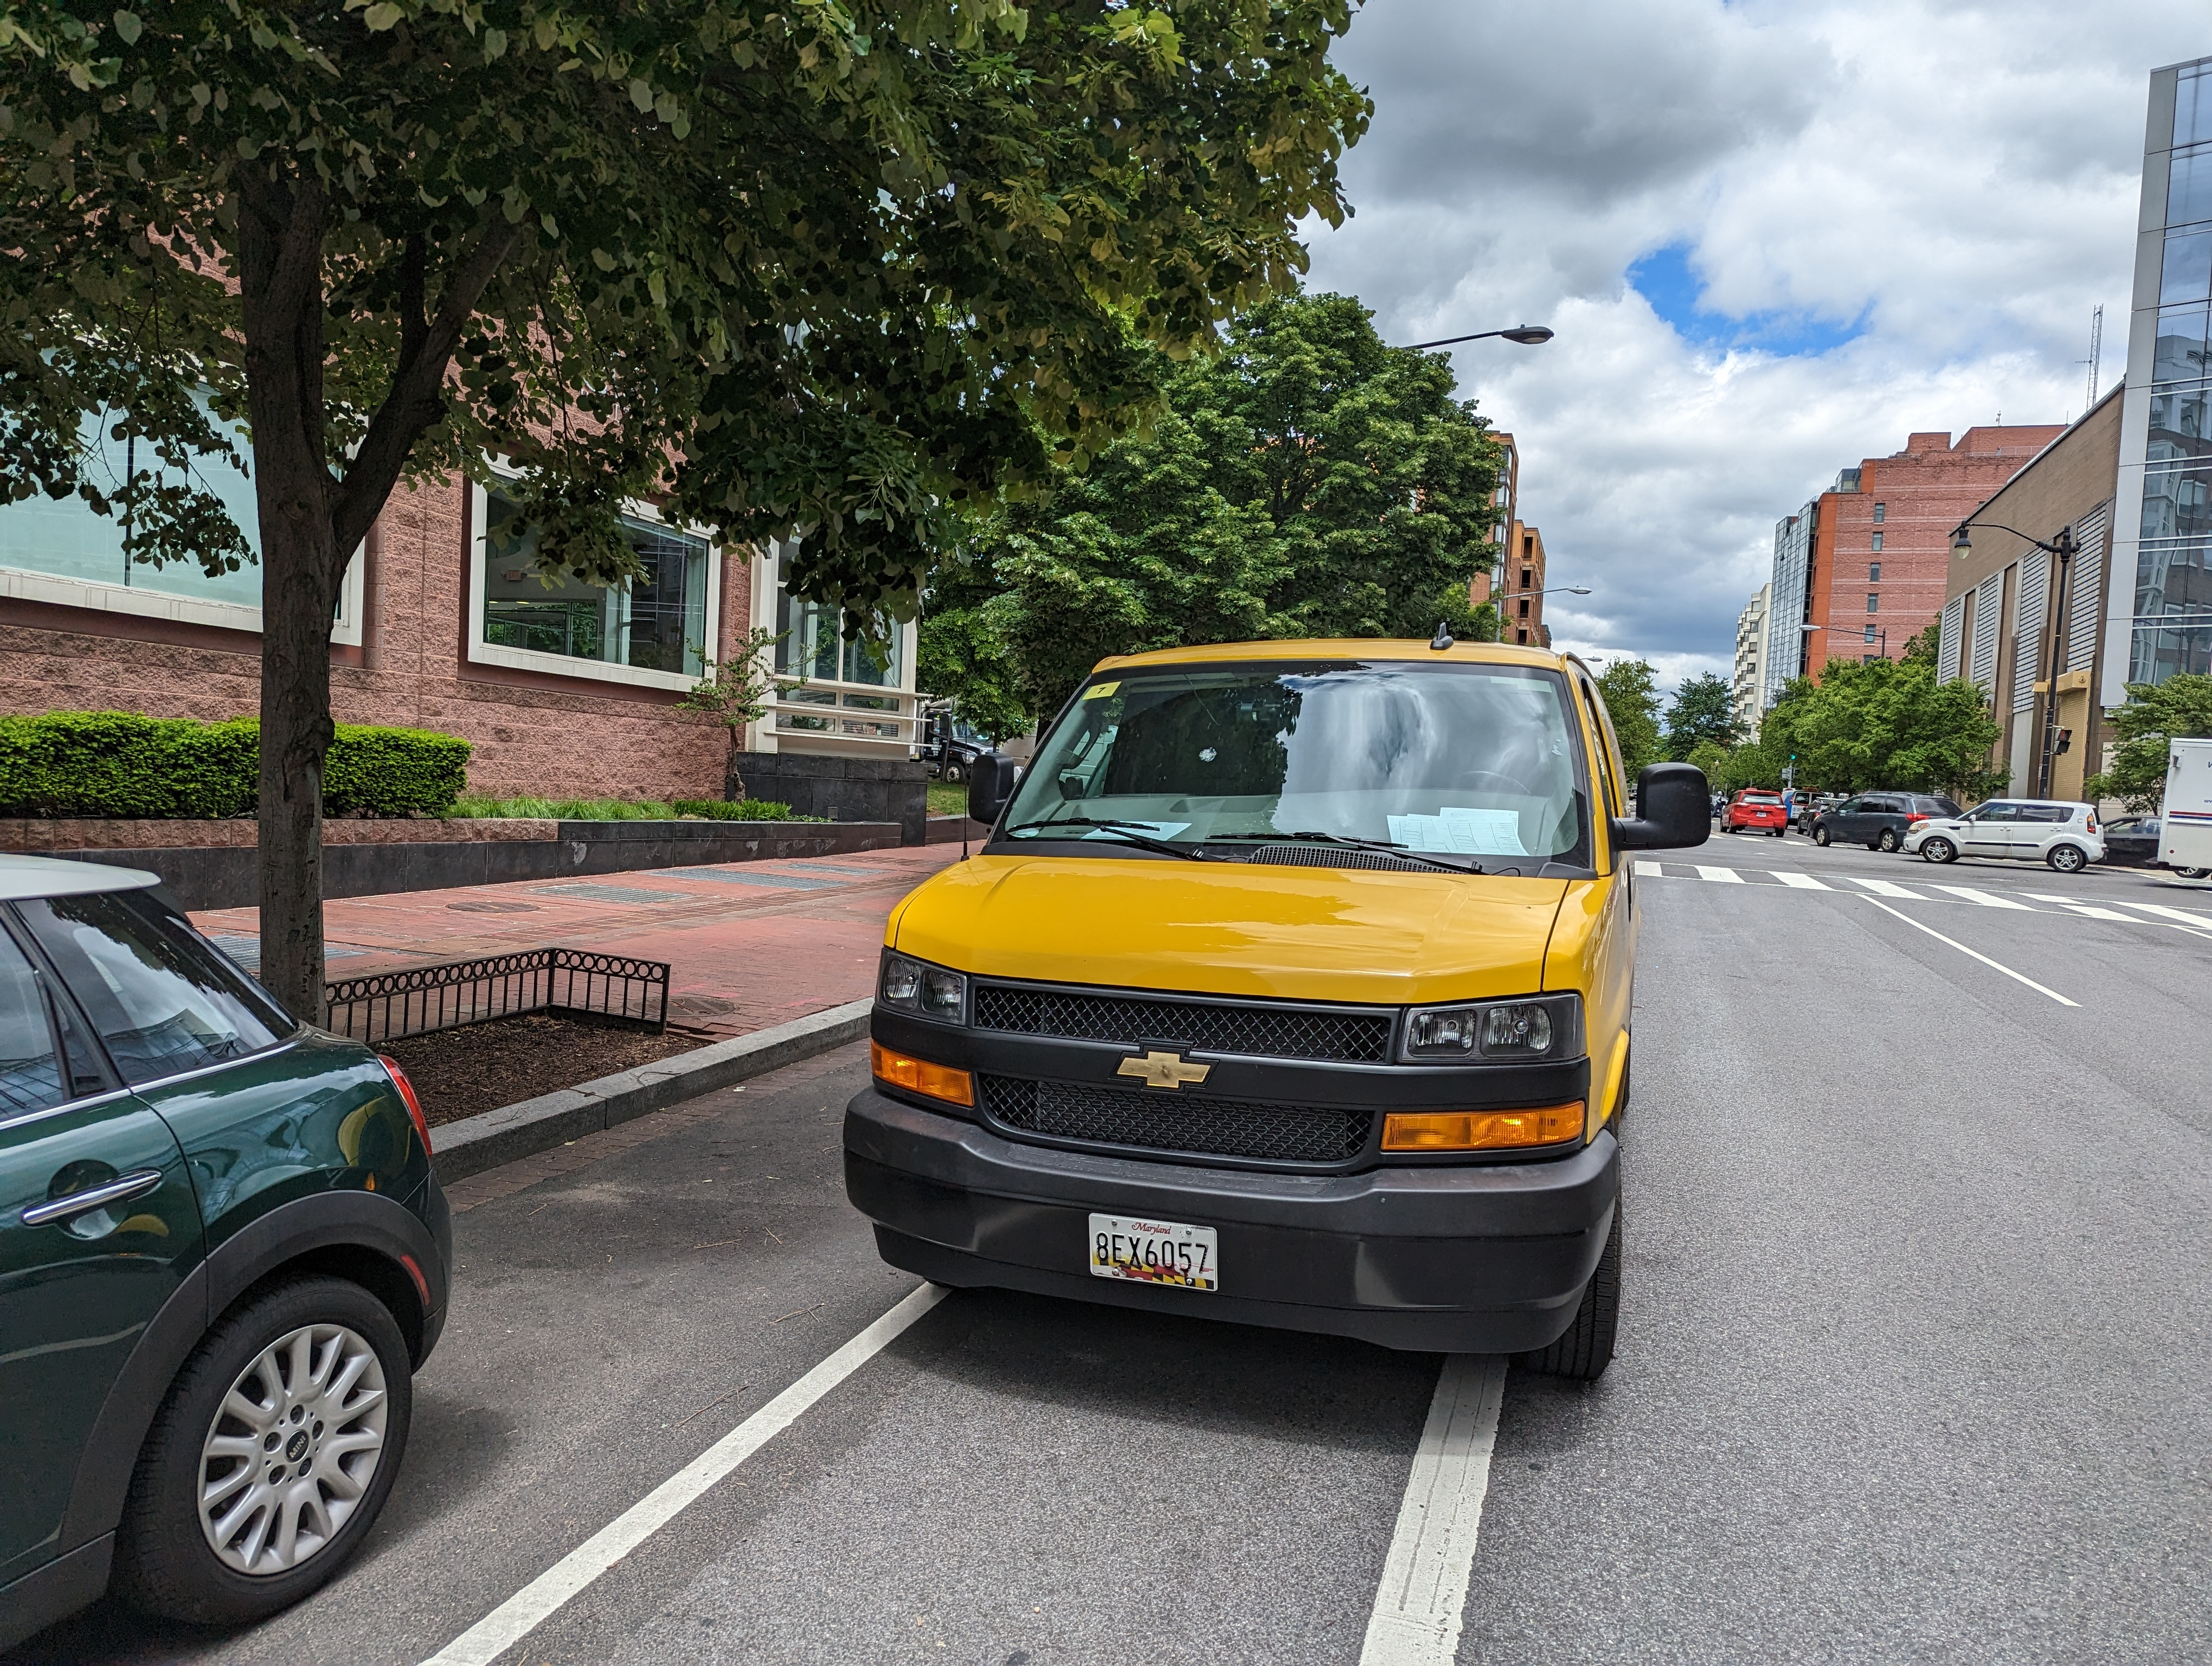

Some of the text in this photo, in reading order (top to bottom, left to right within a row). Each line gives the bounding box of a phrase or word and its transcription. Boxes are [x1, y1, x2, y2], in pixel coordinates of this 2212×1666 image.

[1131, 1222, 1172, 1235] Maryland
[1096, 1232, 1209, 1273] 8EX6057
[289, 1435, 306, 1458] MINI
